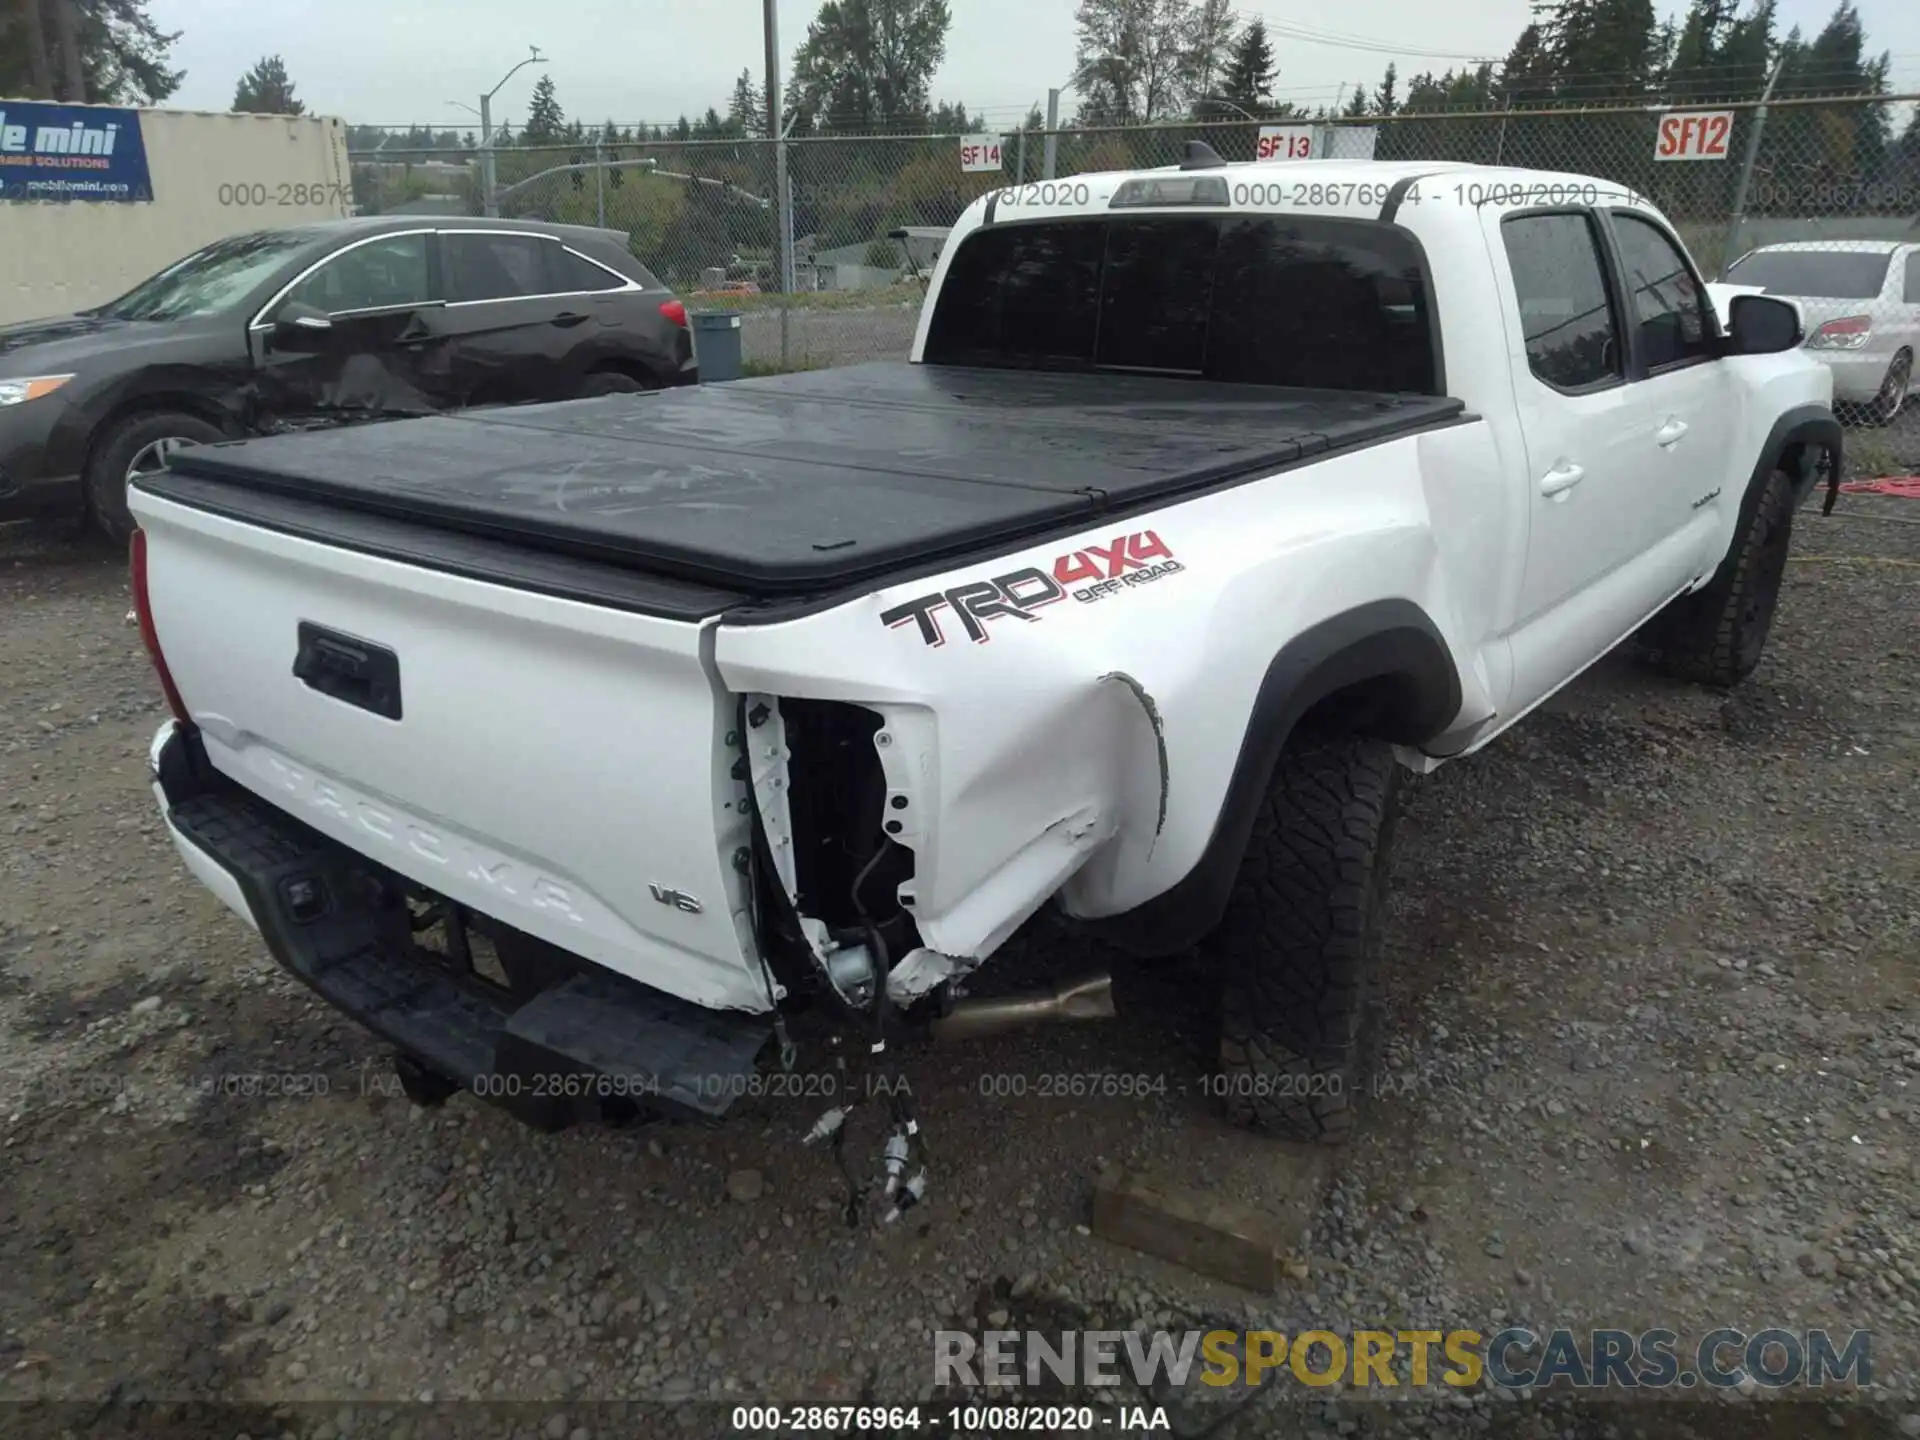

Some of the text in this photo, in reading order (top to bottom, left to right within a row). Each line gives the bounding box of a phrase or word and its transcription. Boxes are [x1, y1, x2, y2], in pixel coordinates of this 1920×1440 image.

[35, 122, 117, 155] mini
[1659, 116, 1729, 156] SF12
[1072, 560, 1185, 604] OFF ROAD
[880, 567, 1068, 648] TRD
[647, 882, 702, 914] V6
